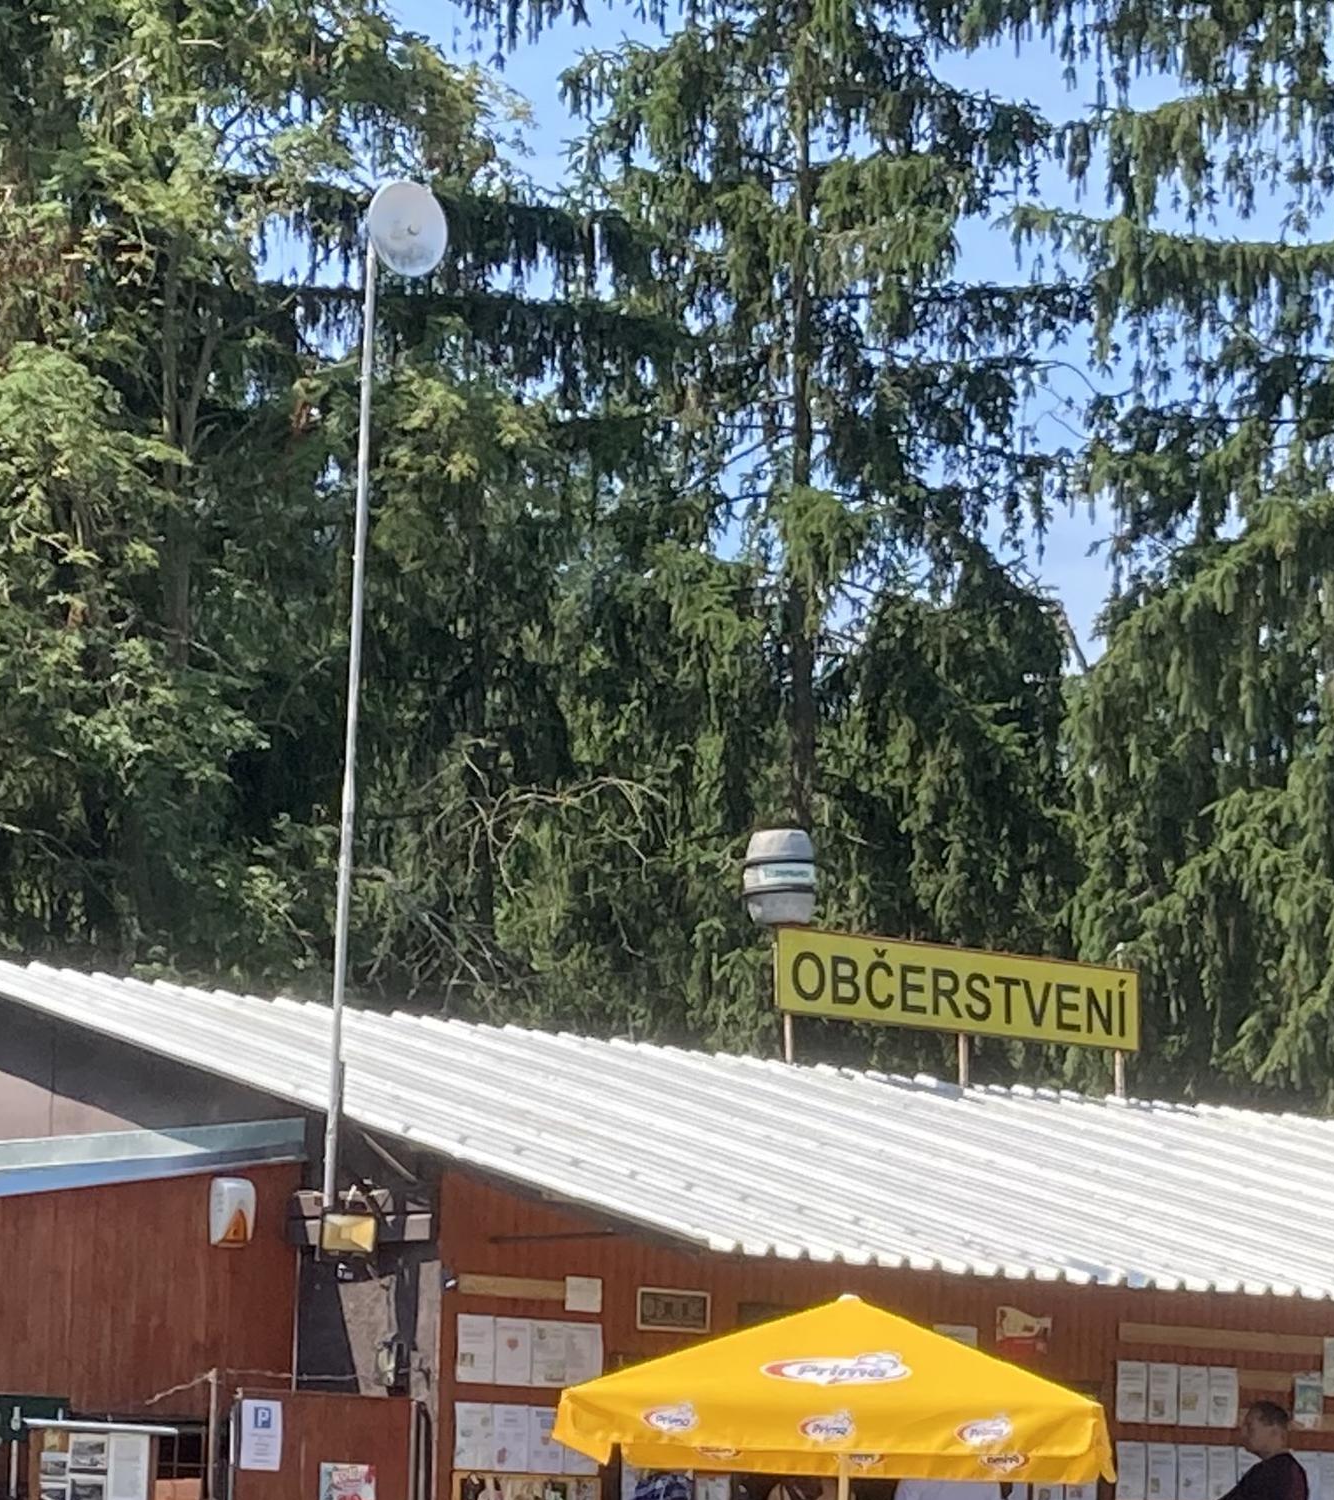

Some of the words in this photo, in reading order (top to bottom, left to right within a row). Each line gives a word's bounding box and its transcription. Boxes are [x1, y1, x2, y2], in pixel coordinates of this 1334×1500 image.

[792, 948, 1125, 1038] OBČERSTVENÍ
[797, 1364, 887, 1378] Prima
[655, 1414, 690, 1428] Prima
[812, 1423, 848, 1436] Prima
